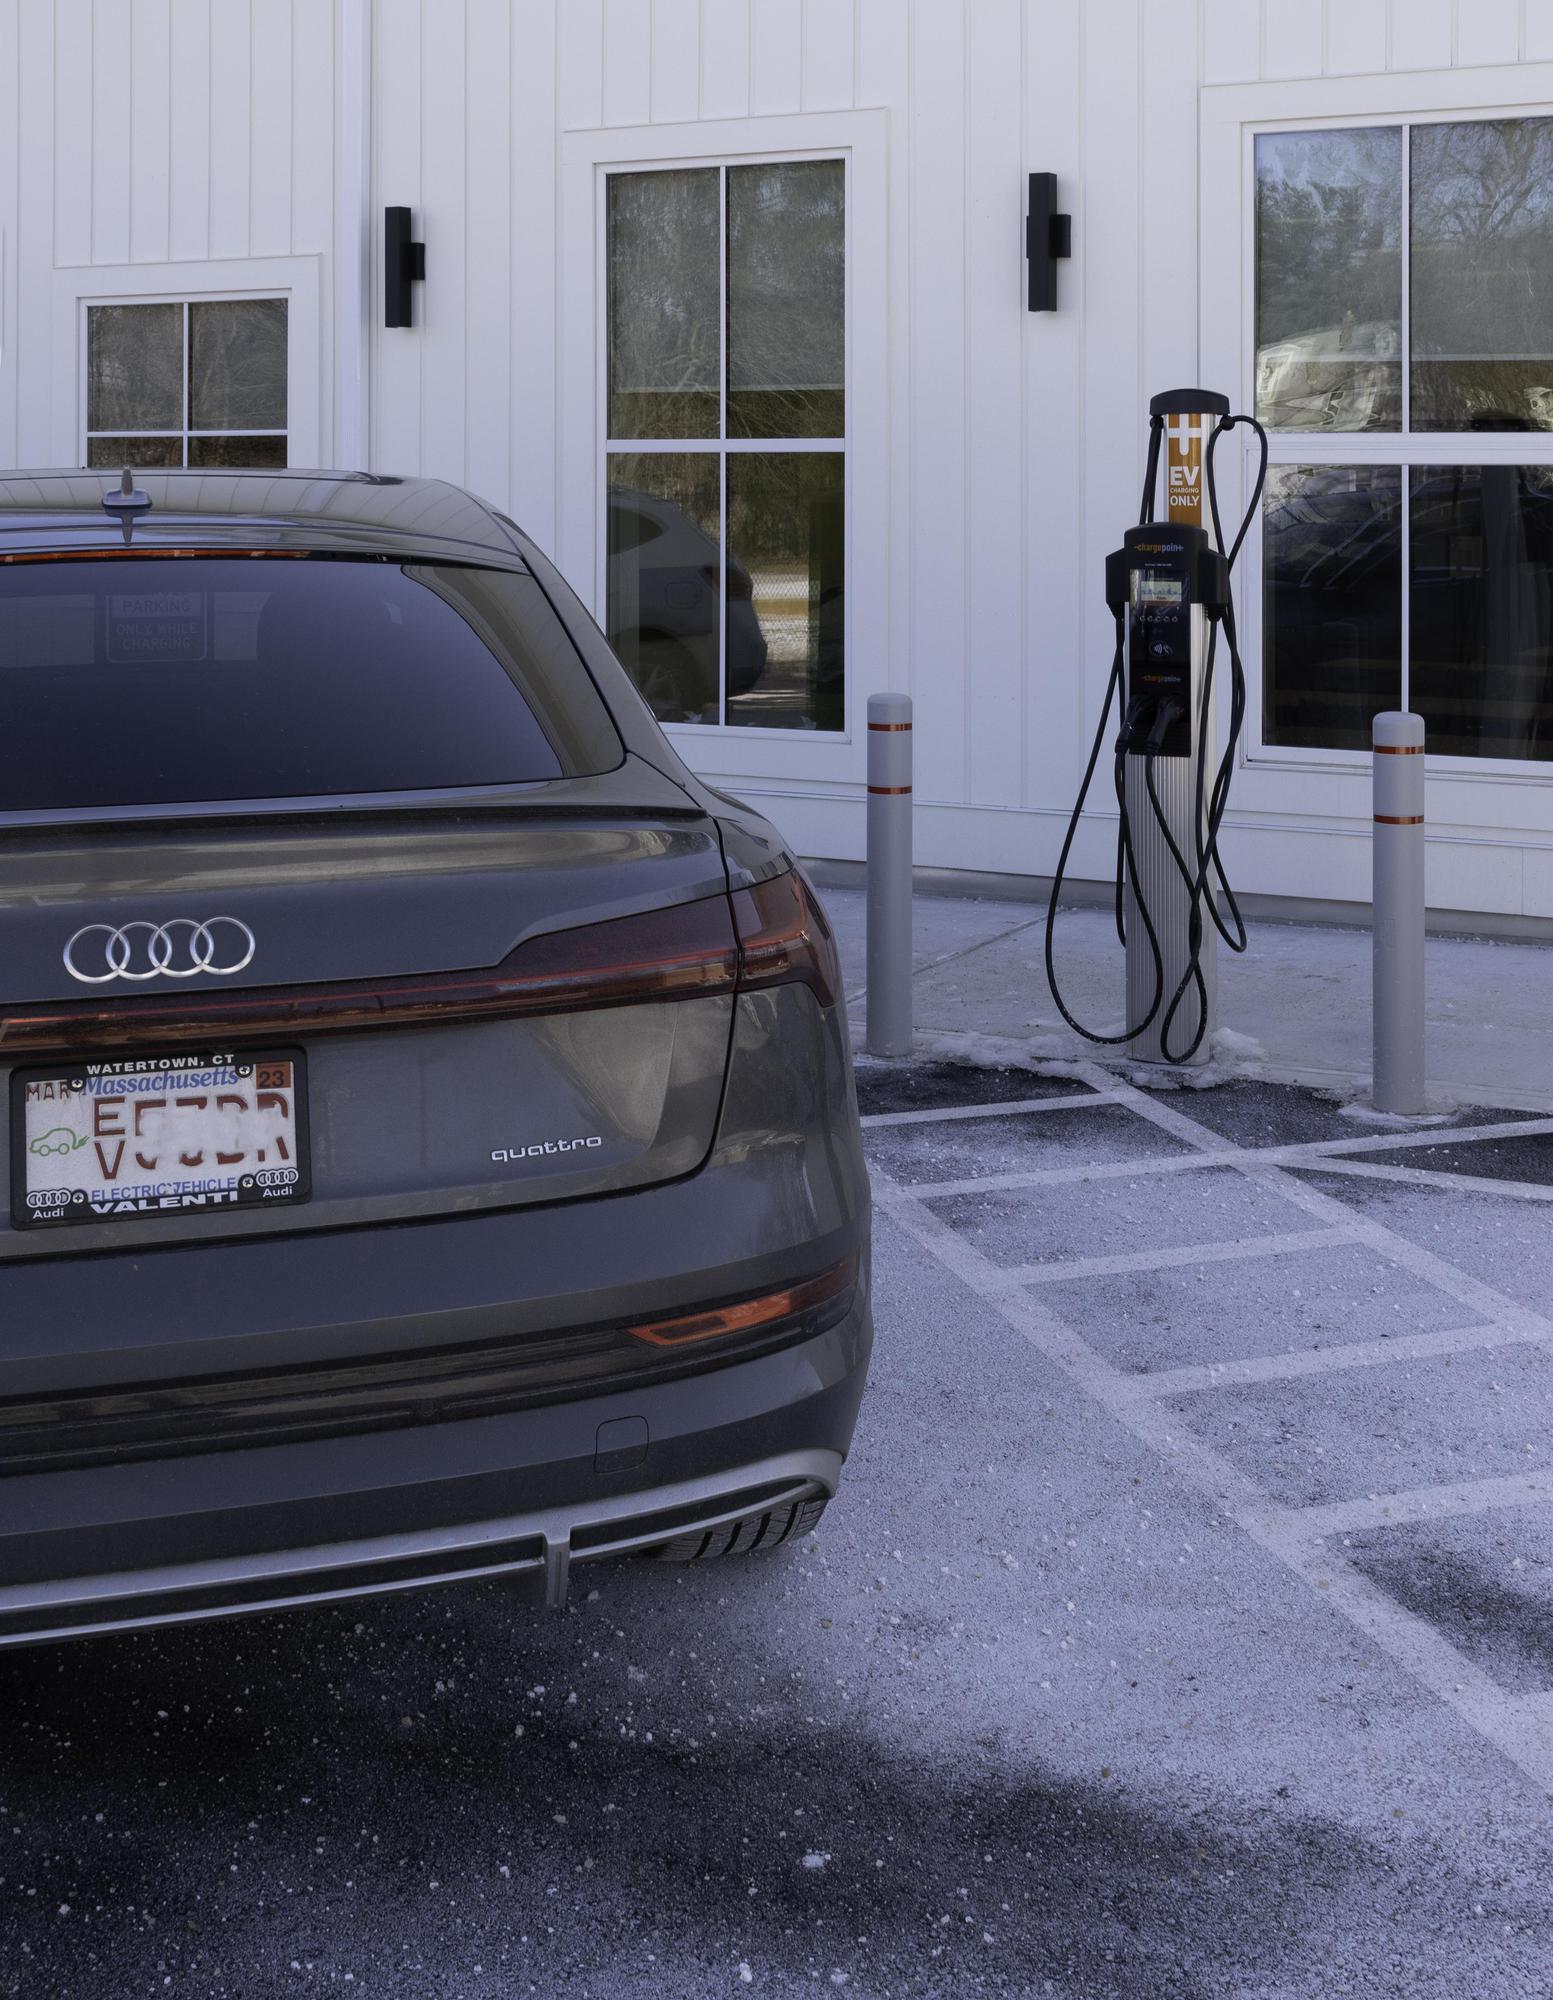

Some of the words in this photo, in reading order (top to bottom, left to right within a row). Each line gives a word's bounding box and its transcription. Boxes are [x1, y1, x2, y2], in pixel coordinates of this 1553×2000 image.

[1170, 465, 1200, 486] EV
[1170, 495, 1200, 507] ONLY
[122, 599, 193, 613] PARKING
[116, 623, 153, 636] ONLY
[157, 622, 200, 635] WHILE
[122, 637, 192, 650] CHARGING
[86, 1057, 205, 1075] WATERTOWN,
[212, 1054, 235, 1065] CT
[26, 1082, 70, 1102] MAR
[81, 1067, 240, 1096] Massachusetts
[259, 1070, 284, 1088] 23
[491, 1136, 602, 1162] quattro
[91, 1182, 168, 1201] ELECTRIC
[263, 1186, 293, 1198] Audi
[90, 1191, 238, 1214] VALENTI
[33, 1208, 64, 1219] Audi
